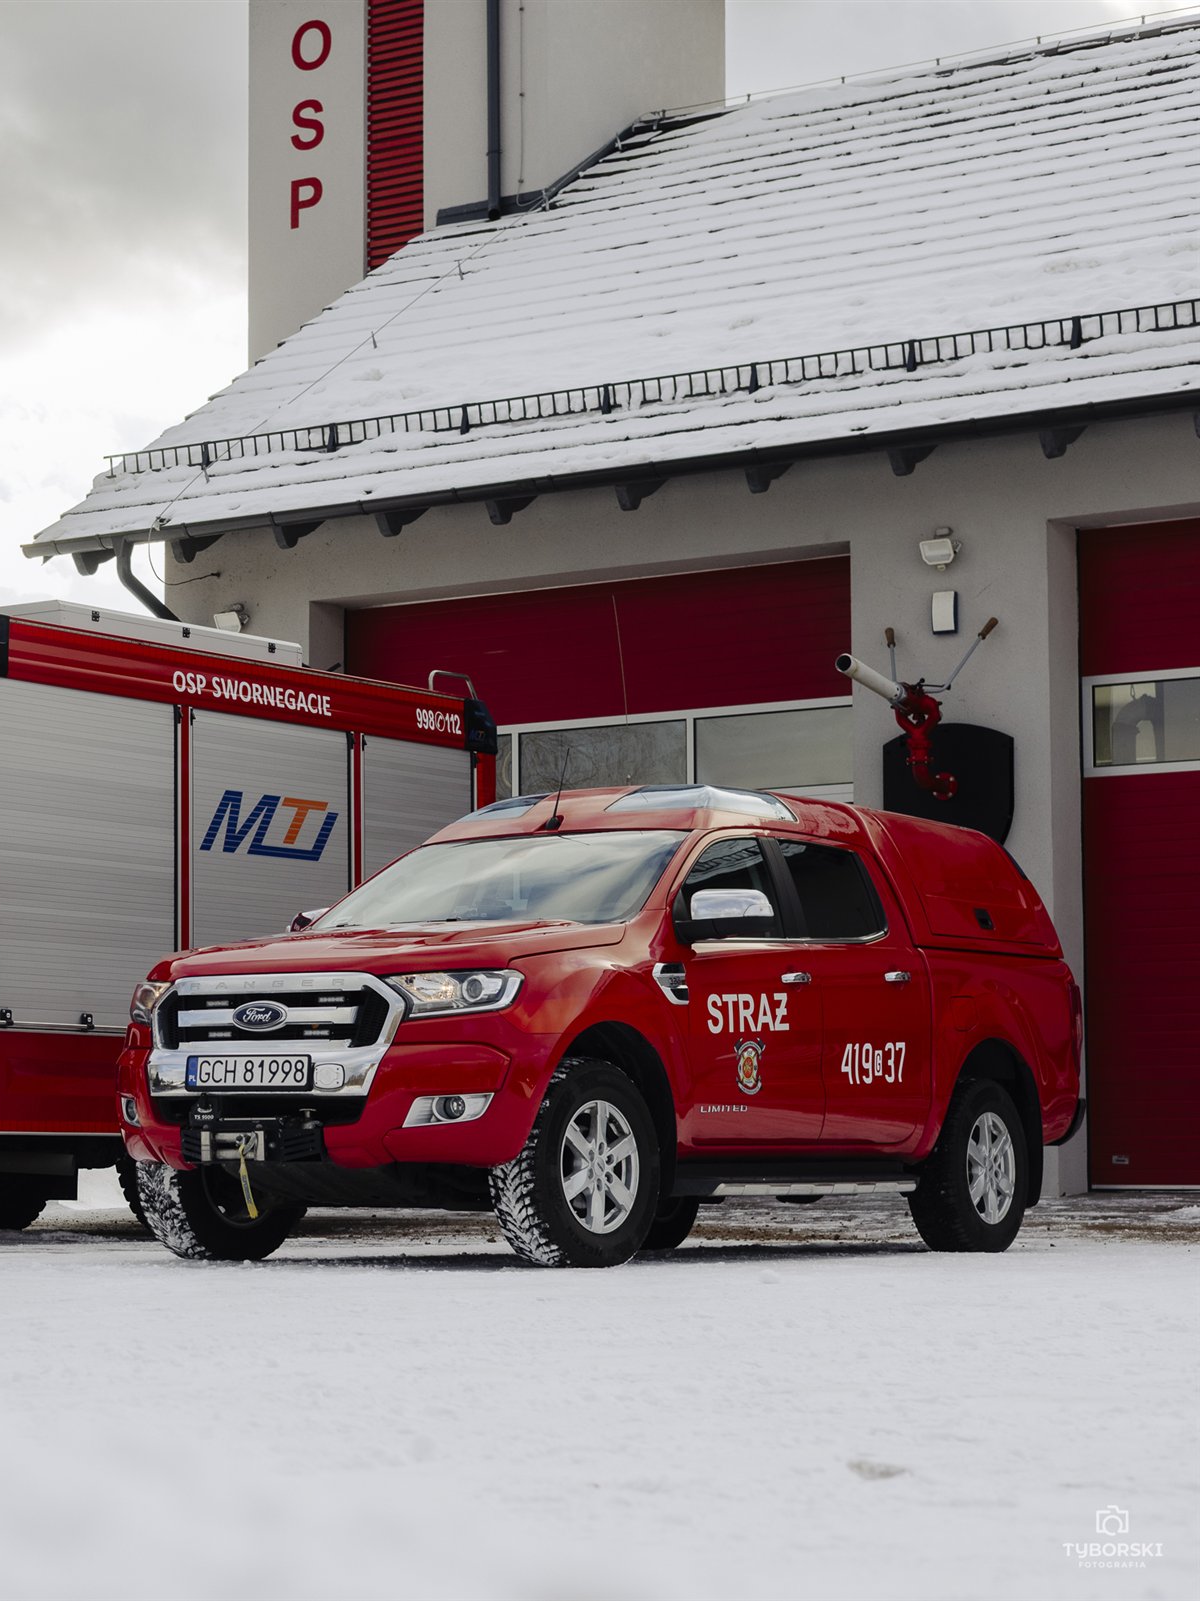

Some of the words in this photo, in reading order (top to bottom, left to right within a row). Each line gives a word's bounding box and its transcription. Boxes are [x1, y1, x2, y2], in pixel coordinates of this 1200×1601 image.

[290, 19, 332, 230] OSP
[172, 670, 207, 695] OSP
[211, 676, 333, 717] SWORNEGACIE
[415, 707, 435, 731] 998
[445, 713, 463, 735] 112
[190, 978, 345, 991] RANGER
[241, 1005, 273, 1024] Ford
[198, 1059, 237, 1084] GCH
[242, 1059, 305, 1084] 81998
[699, 1104, 748, 1113] LIMITED
